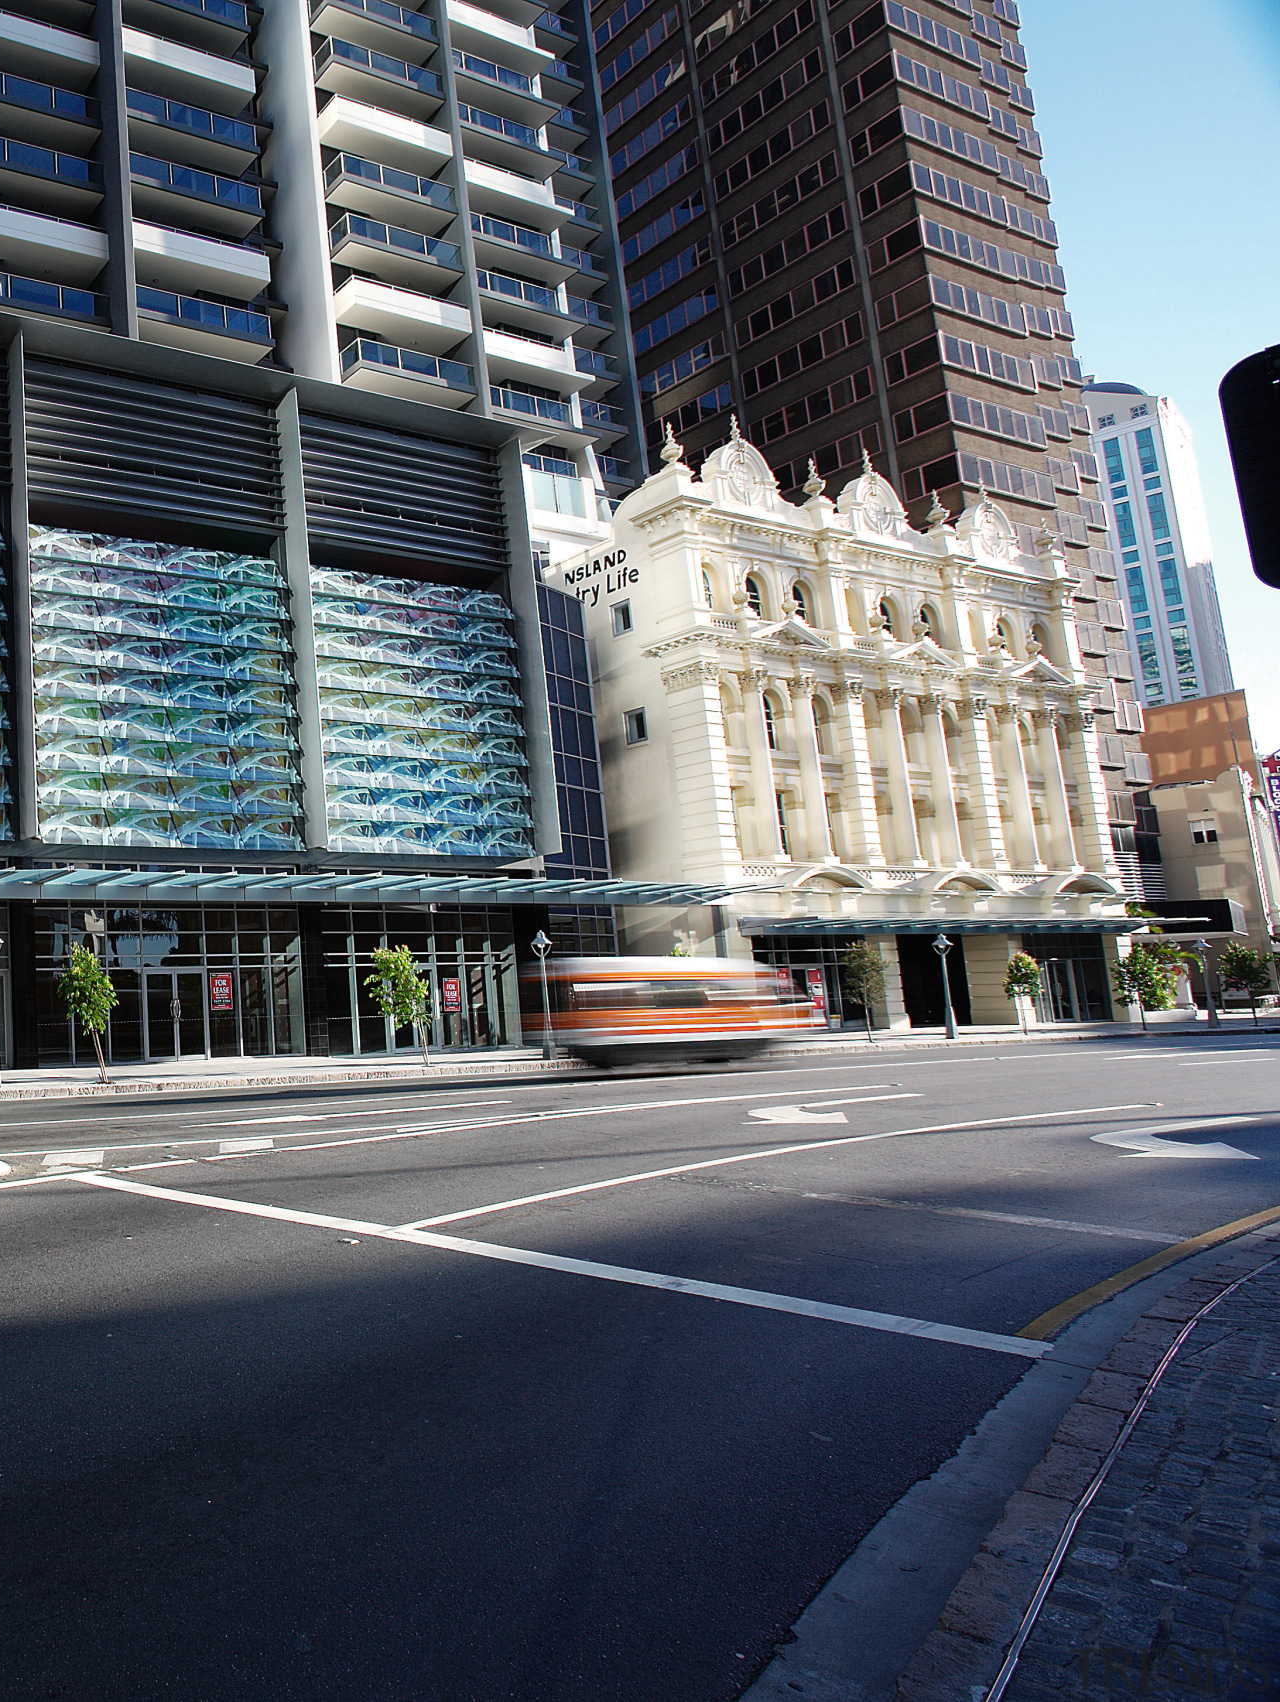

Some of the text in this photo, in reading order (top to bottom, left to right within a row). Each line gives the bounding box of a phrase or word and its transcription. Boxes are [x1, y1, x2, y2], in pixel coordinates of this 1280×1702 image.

[564, 549, 627, 587] NSLAND
[575, 566, 640, 607] try Life
[215, 979, 227, 987] FOR
